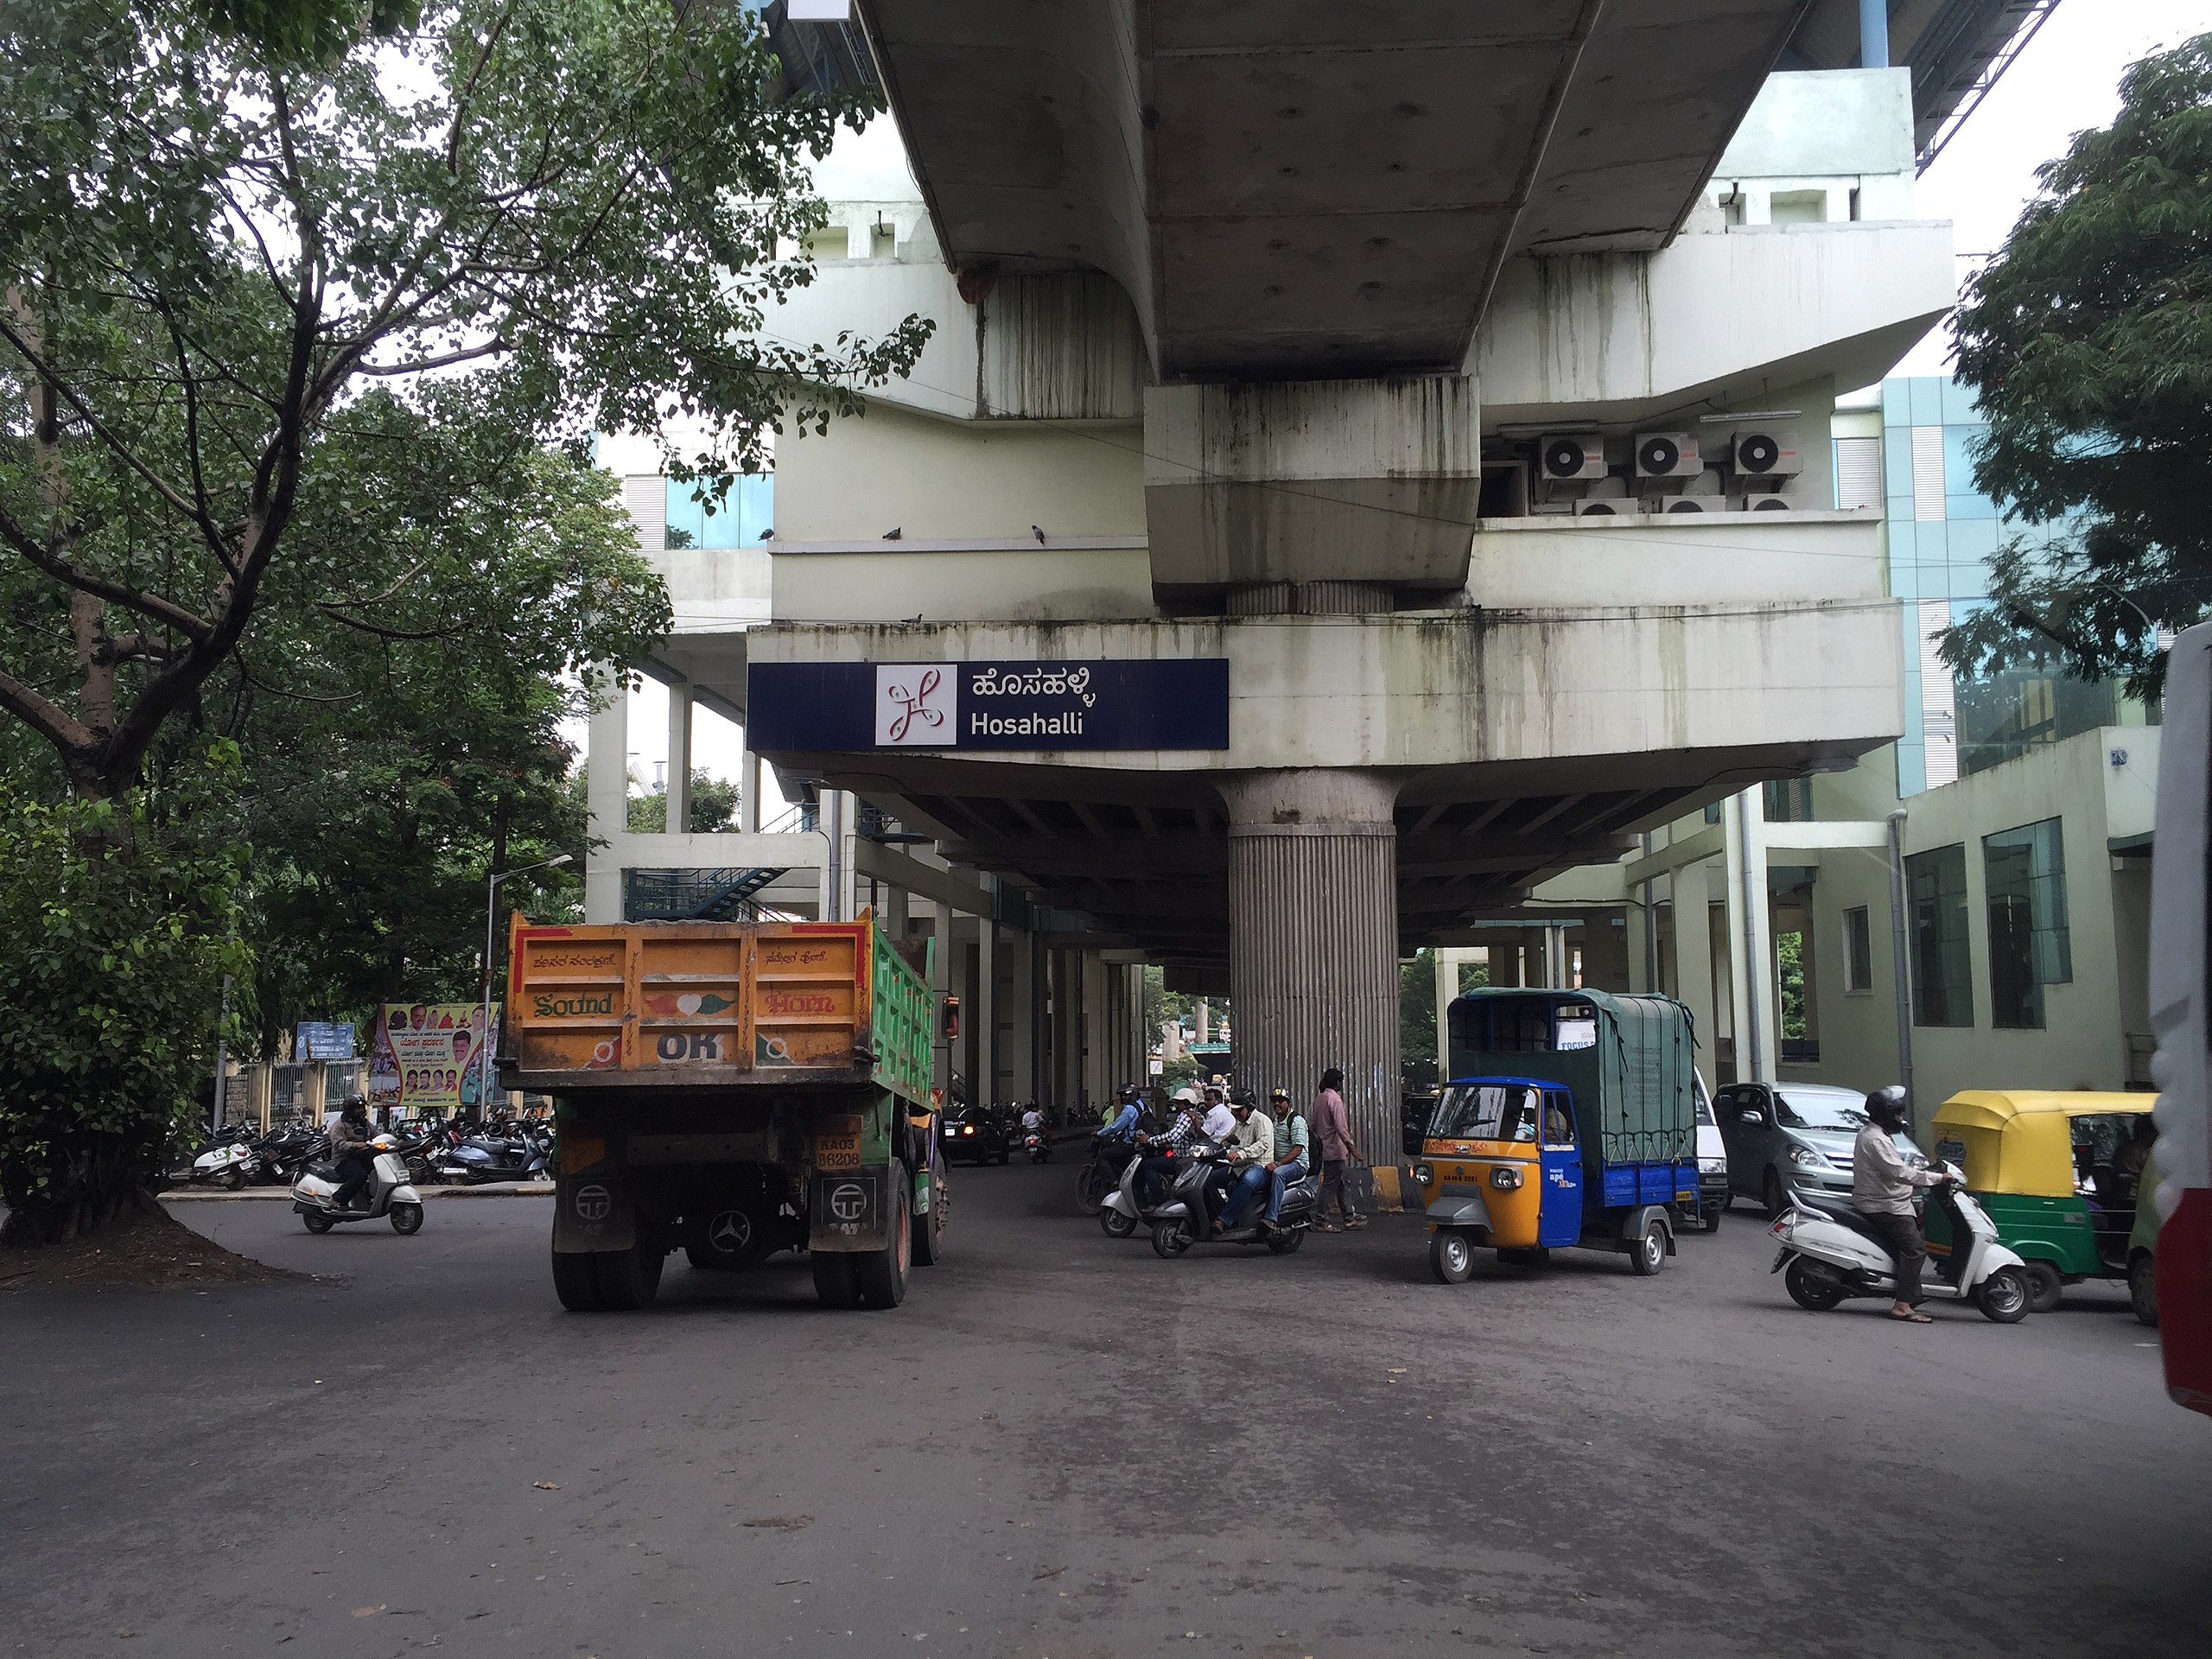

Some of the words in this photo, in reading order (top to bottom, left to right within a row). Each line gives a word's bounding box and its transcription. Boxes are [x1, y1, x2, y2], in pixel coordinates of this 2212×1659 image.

[972, 666, 1096, 708] ಹೊಸಹಳ್ಳಿ
[971, 712, 1084, 735] Hosahalli
[533, 993, 613, 1017] Sound
[765, 992, 836, 1015] Horn
[657, 1033, 724, 1063] OK
[819, 1139, 855, 1151] KA03
[818, 1153, 860, 1166] B6208
